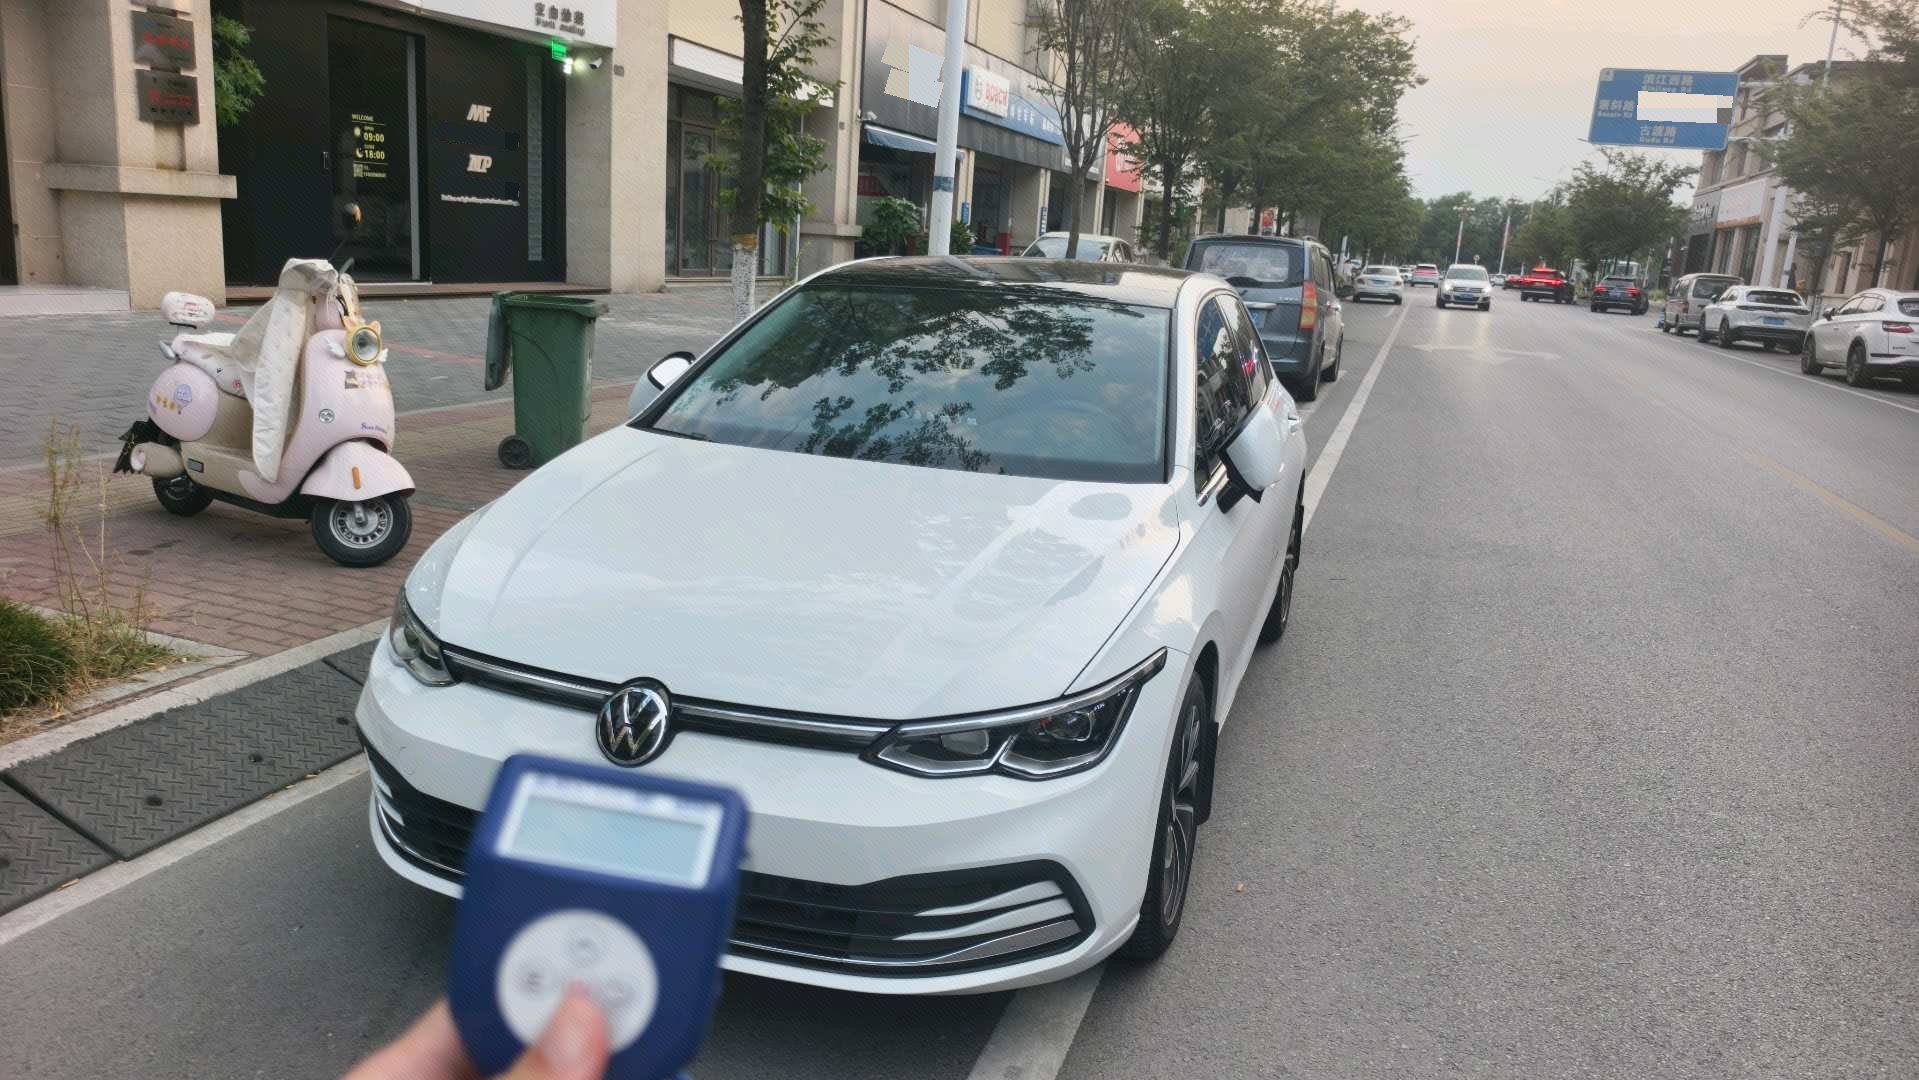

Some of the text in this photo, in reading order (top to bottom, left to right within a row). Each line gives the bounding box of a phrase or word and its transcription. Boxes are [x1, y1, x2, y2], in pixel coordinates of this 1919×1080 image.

[1642, 74, 1694, 87] 滨江西路
[985, 82, 1008, 106] BOSCH
[1639, 125, 1678, 137] 古渡路
[363, 132, 385, 143] 09:00
[364, 150, 385, 160] 18:00
